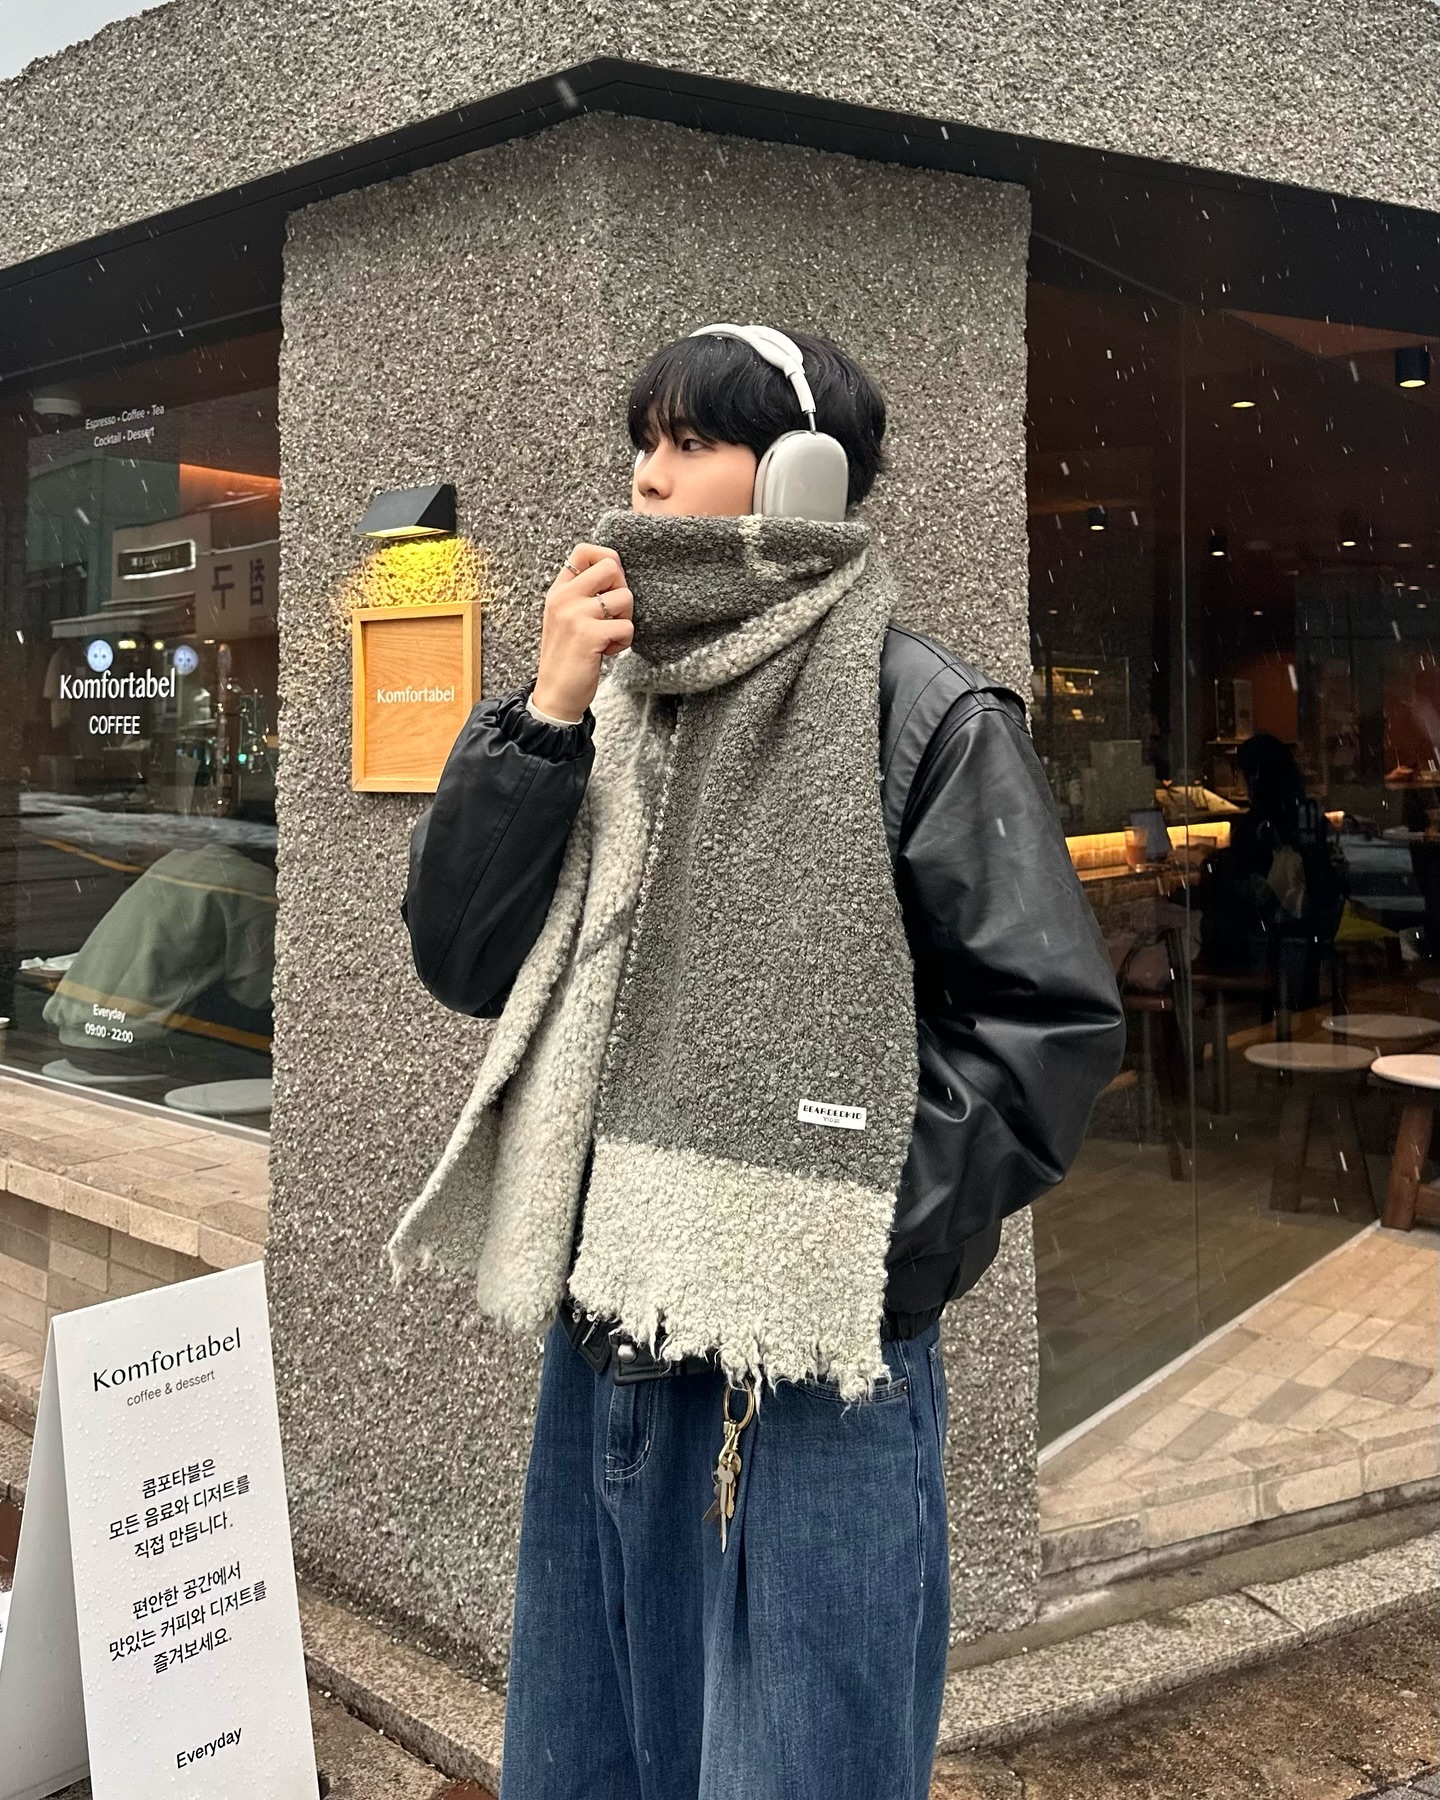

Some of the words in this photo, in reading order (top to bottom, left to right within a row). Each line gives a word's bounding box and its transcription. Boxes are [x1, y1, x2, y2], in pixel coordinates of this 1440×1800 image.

[85, 415, 116, 431] Espresso
[121, 408, 145, 422] Coffee
[151, 404, 165, 416] Tea
[93, 431, 122, 447] Cocktail
[127, 426, 155, 441] Dessert
[60, 667, 176, 699] Komfortabel
[376, 685, 455, 704] Komfortabel
[89, 715, 141, 735] COFFEE
[85, 1022, 107, 1038] 09:00
[111, 1027, 134, 1043] 22:00
[93, 1003, 126, 1023] Everyday
[93, 1326, 241, 1392] Komfortabel
[126, 1387, 162, 1407] coffee
[164, 1382, 173, 1395] &
[175, 1370, 216, 1392] dessert
[142, 1458, 216, 1499] 콤포타블은
[109, 1514, 140, 1540] 모든
[144, 1496, 189, 1528] 음료와
[193, 1474, 250, 1508] 디저트를
[134, 1534, 165, 1558] 직접
[169, 1511, 233, 1548] 만듭니다.
[132, 1585, 179, 1620] 편안한
[183, 1560, 241, 1600] 공간에서
[109, 1628, 157, 1662] 맛있는
[160, 1605, 206, 1638] 커피와
[210, 1580, 267, 1616] 디저트를
[153, 1627, 232, 1674] 즐겨보세요.
[176, 1727, 242, 1769] Everyday
